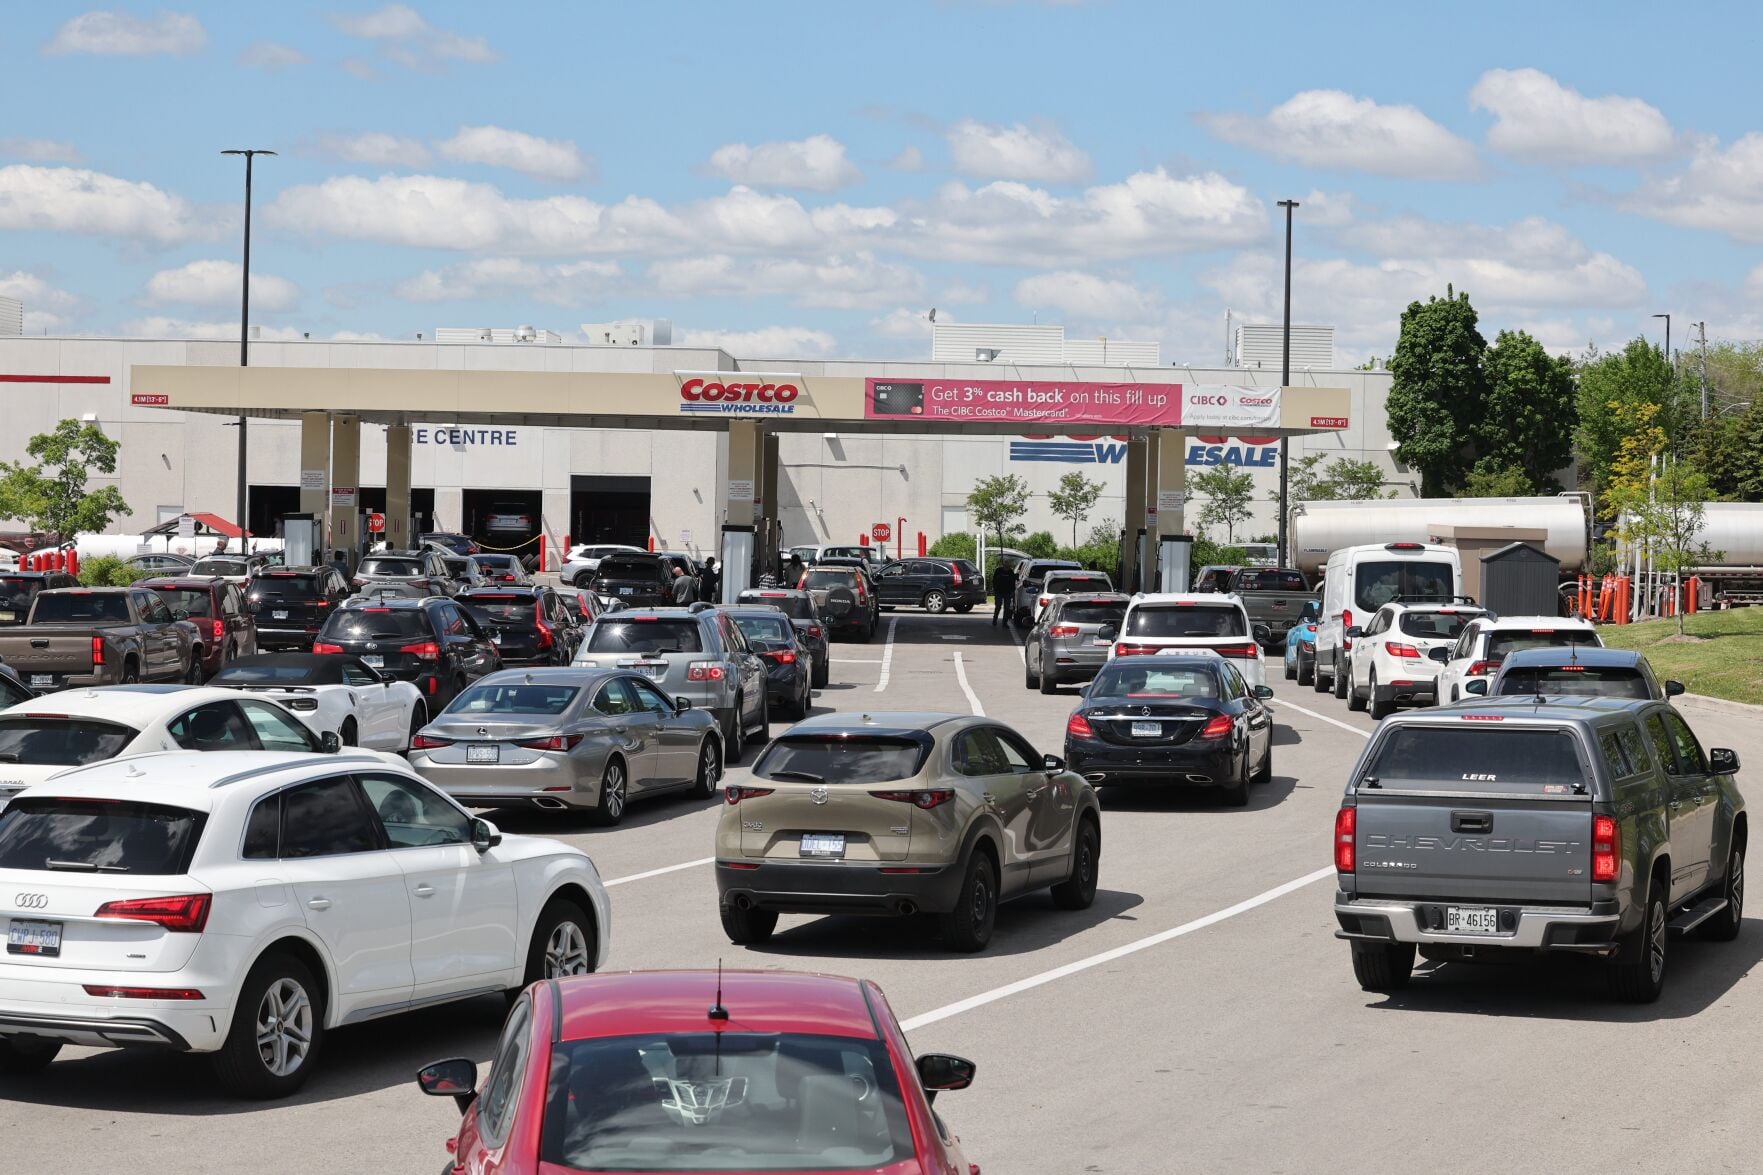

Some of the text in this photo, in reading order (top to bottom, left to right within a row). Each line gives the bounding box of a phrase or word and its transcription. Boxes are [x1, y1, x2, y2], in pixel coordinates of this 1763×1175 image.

[681, 379, 798, 403] COSTCO
[931, 386, 959, 401] Get
[963, 387, 983, 401] 3%
[987, 388, 1023, 402] cash
[1070, 392, 1089, 404] on
[1094, 389, 1121, 404] this
[1126, 390, 1143, 405] fill
[1148, 394, 1167, 408] up
[1190, 395, 1216, 406] CIBC
[721, 404, 795, 414] WHOLESALE
[932, 406, 950, 415] The
[952, 406, 974, 416] CIBC
[434, 429, 517, 446] CENTRE
[873, 528, 890, 537] STOP
[1461, 773, 1497, 782] LEER
[1366, 833, 1581, 854] CHEVROLET
[1363, 861, 1417, 869] COLORADO
[1448, 912, 1496, 927] BR 46156
